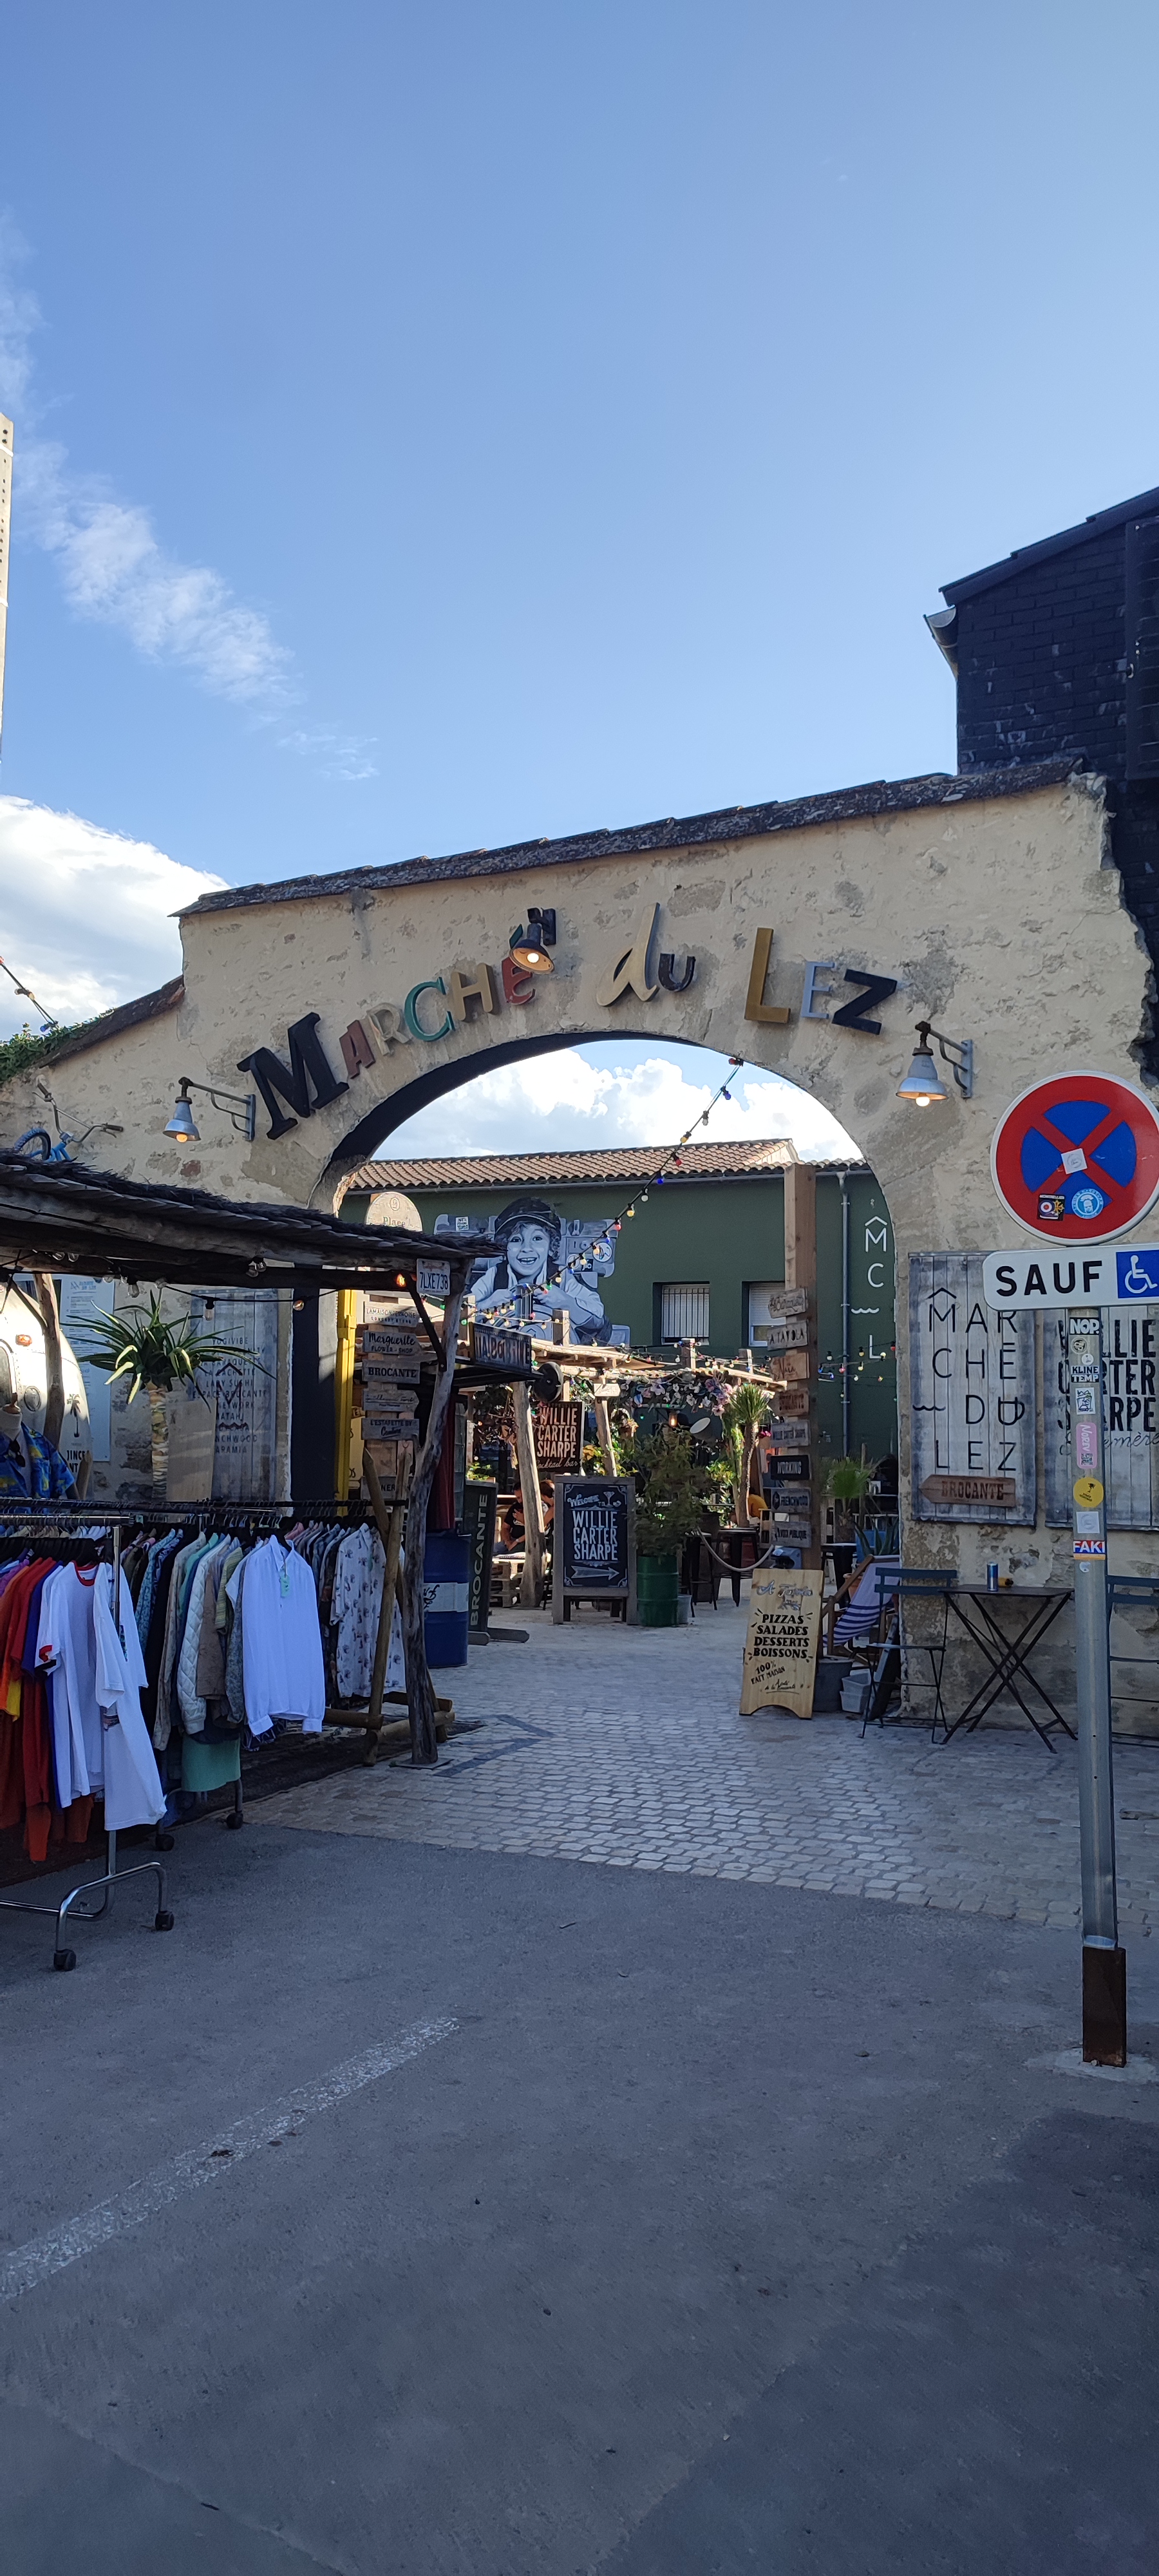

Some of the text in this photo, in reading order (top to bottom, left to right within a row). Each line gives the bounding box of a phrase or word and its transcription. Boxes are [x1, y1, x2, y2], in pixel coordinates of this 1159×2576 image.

[596, 902, 695, 1007] du
[744, 927, 898, 1035] LEZ
[419, 1271, 448, 1290] 7LXE738
[995, 1260, 1102, 1297] SAUF
[777, 1327, 804, 1343] TAVOLA
[368, 1367, 418, 1378] BROCANTE
[540, 1407, 578, 1426] WILLIE
[538, 1424, 577, 1441] CARTER
[536, 1441, 577, 1458] SHARPE
[936, 1439, 1017, 1471] LEZ
[563, 1457, 578, 1467] bar
[941, 1481, 1004, 1501] BROCANTE
[572, 1510, 618, 1528] WILLIE
[573, 1527, 618, 1544] CARTER
[470, 1494, 488, 1625] BROCANTE
[574, 1544, 618, 1560] SHARPE
[762, 1614, 804, 1624] PIZZAS
[757, 1625, 809, 1636] SALADES
[754, 1636, 810, 1647] DESSERTS
[753, 1647, 808, 1659] BOISSONS
[751, 1673, 765, 1685] FAIT
[766, 1665, 786, 1680] MAISON
[755, 1660, 777, 1675] 100%
